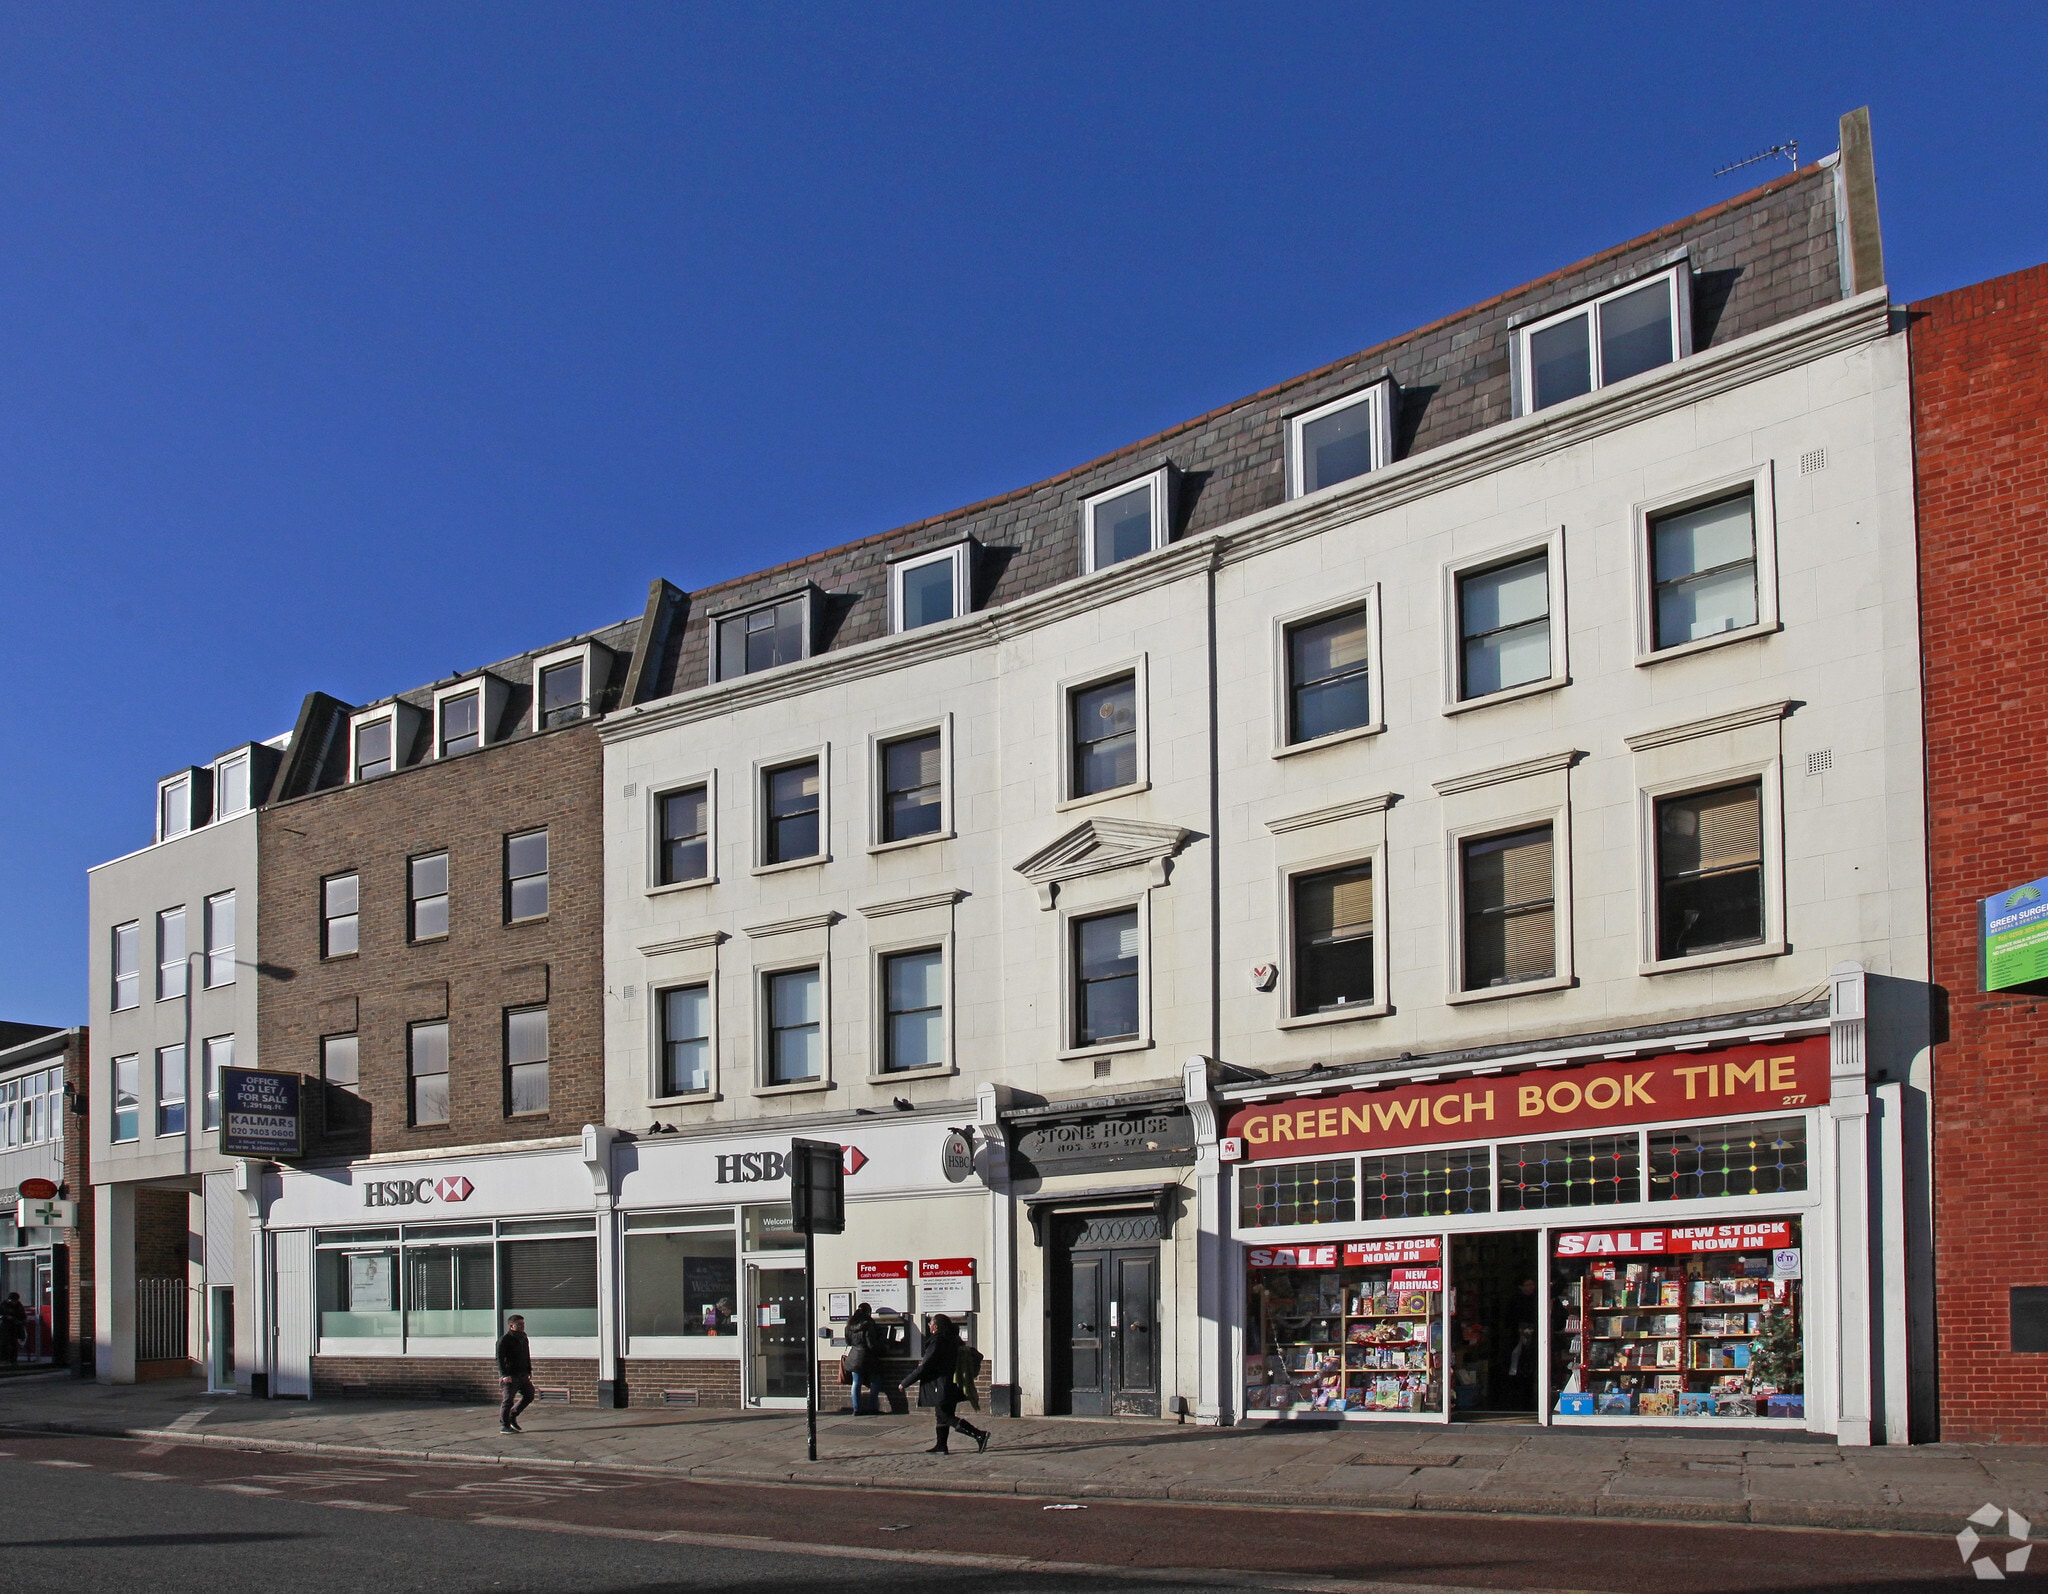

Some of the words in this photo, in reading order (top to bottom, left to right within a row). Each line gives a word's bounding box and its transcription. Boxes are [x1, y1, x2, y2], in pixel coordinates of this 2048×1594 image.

[1990, 913, 2017, 929] GREEN
[1990, 923, 2014, 934] MEDICAL
[246, 1076, 279, 1086] OFFICE
[241, 1084, 255, 1092] TO
[259, 1085, 276, 1094] LET
[280, 1087, 285, 1096] /
[237, 1092, 258, 1101] FOR
[262, 1094, 287, 1104] SALE
[1243, 1090, 1494, 1144] GREENWICH
[1518, 1071, 1656, 1118] BOOK
[1673, 1055, 1797, 1100] TIME
[1782, 1094, 1807, 1105] 277
[231, 1127, 247, 1135] 020
[249, 1128, 269, 1136] 7403
[272, 1129, 294, 1137] 0600
[1037, 1125, 1095, 1144] STONE
[1104, 1118, 1168, 1138] HOUSE
[1124, 1138, 1144, 1147] 277
[948, 1155, 970, 1168] HSBC
[363, 1178, 434, 1207] HSBC
[1672, 1226, 1715, 1239] NEW
[1719, 1222, 1786, 1236] STOCK
[1347, 1242, 1381, 1253] NEW
[1384, 1238, 1437, 1250] STOCK
[1557, 1231, 1663, 1254] SALE
[1691, 1237, 1740, 1250] NOW
[1743, 1236, 1764, 1247] IN
[1250, 1247, 1334, 1266] SALE
[1362, 1251, 1402, 1263] NOW
[1403, 1250, 1419, 1260] IN
[861, 1264, 877, 1272] Free
[922, 1262, 939, 1270] Free
[1405, 1270, 1427, 1280] NEW
[1393, 1280, 1439, 1290] ARRIVALS
[406, 1475, 646, 1504] BUS
